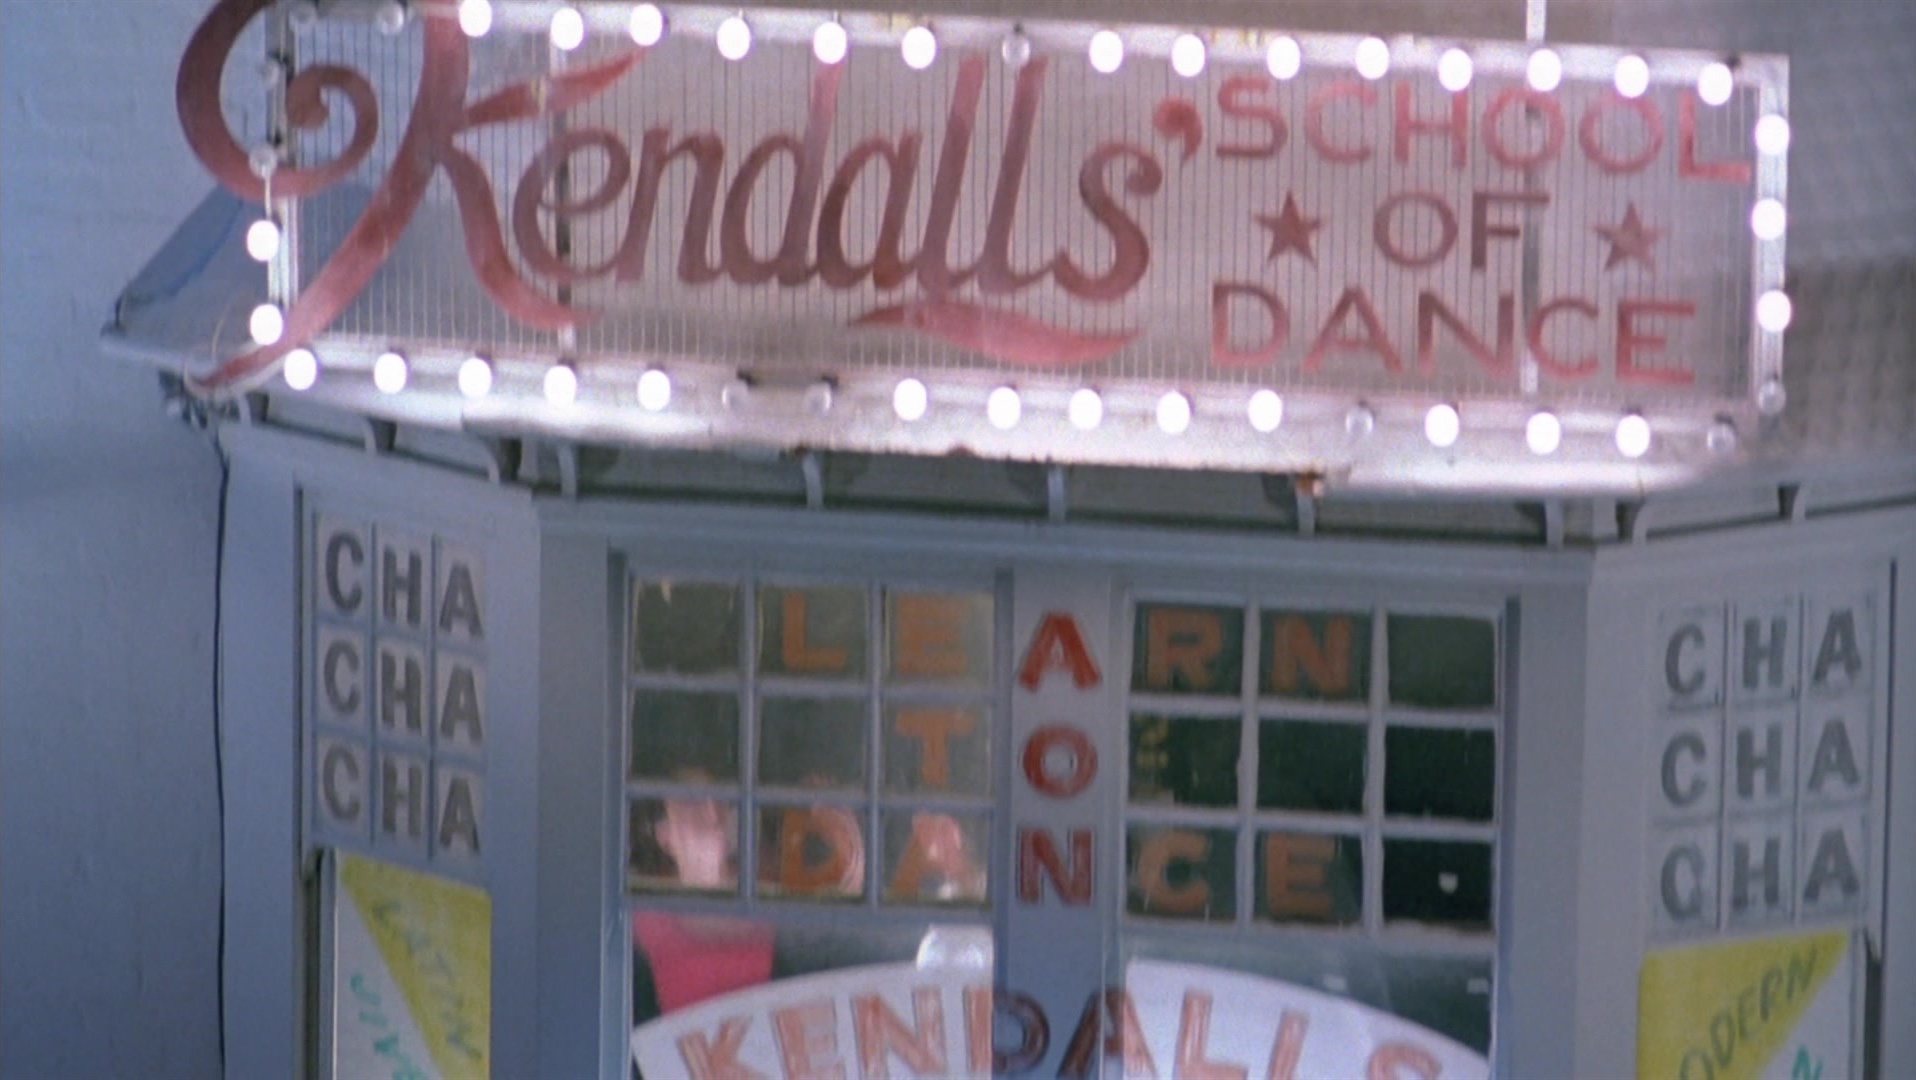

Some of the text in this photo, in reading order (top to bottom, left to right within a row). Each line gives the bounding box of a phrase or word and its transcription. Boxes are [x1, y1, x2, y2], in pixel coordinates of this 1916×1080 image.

[1215, 76, 1752, 184] SCHOOL
[1373, 190, 1551, 272] OF
[1211, 281, 1697, 386] DANCE
[325, 530, 484, 641] CHA
[323, 639, 484, 745] CHA
[781, 593, 1354, 694] LEARN
[1665, 606, 1863, 697] CHA
[322, 742, 482, 857] CHA
[895, 707, 1098, 799] TO
[1660, 716, 1860, 808] CHA
[780, 803, 1338, 916] DANCE
[1659, 827, 1860, 922] CHA
